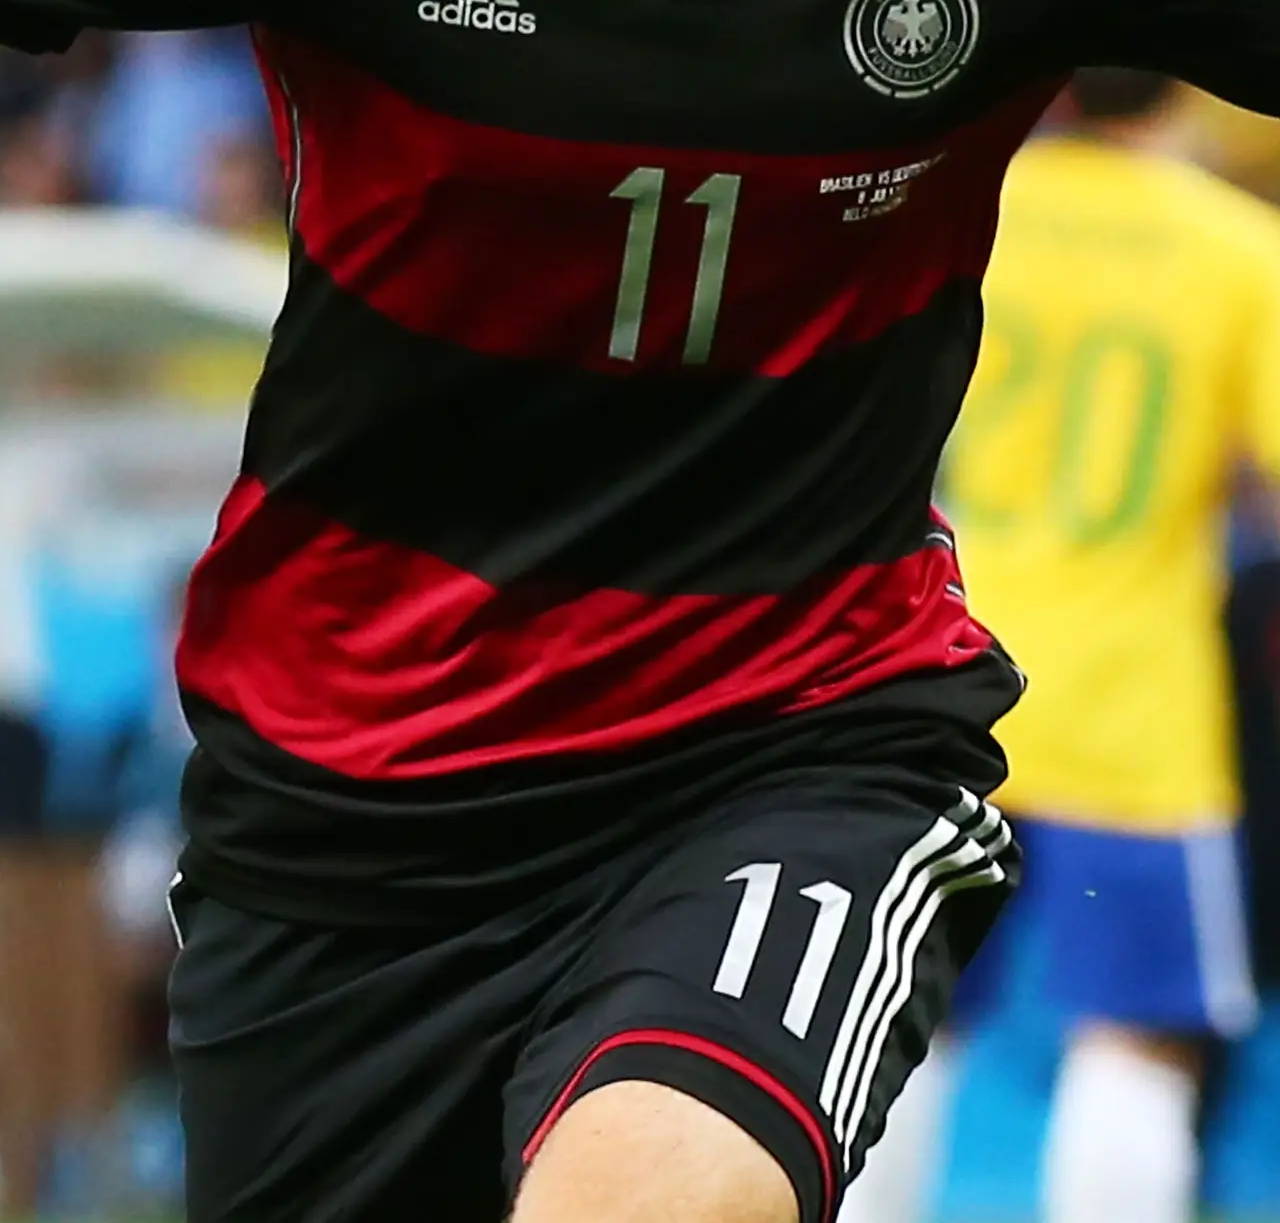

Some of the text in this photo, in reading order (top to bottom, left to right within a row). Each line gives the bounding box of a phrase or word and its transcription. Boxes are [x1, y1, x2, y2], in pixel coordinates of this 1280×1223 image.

[609, 166, 742, 365] 11
[942, 307, 1177, 552] 20
[712, 862, 853, 1041] 11
